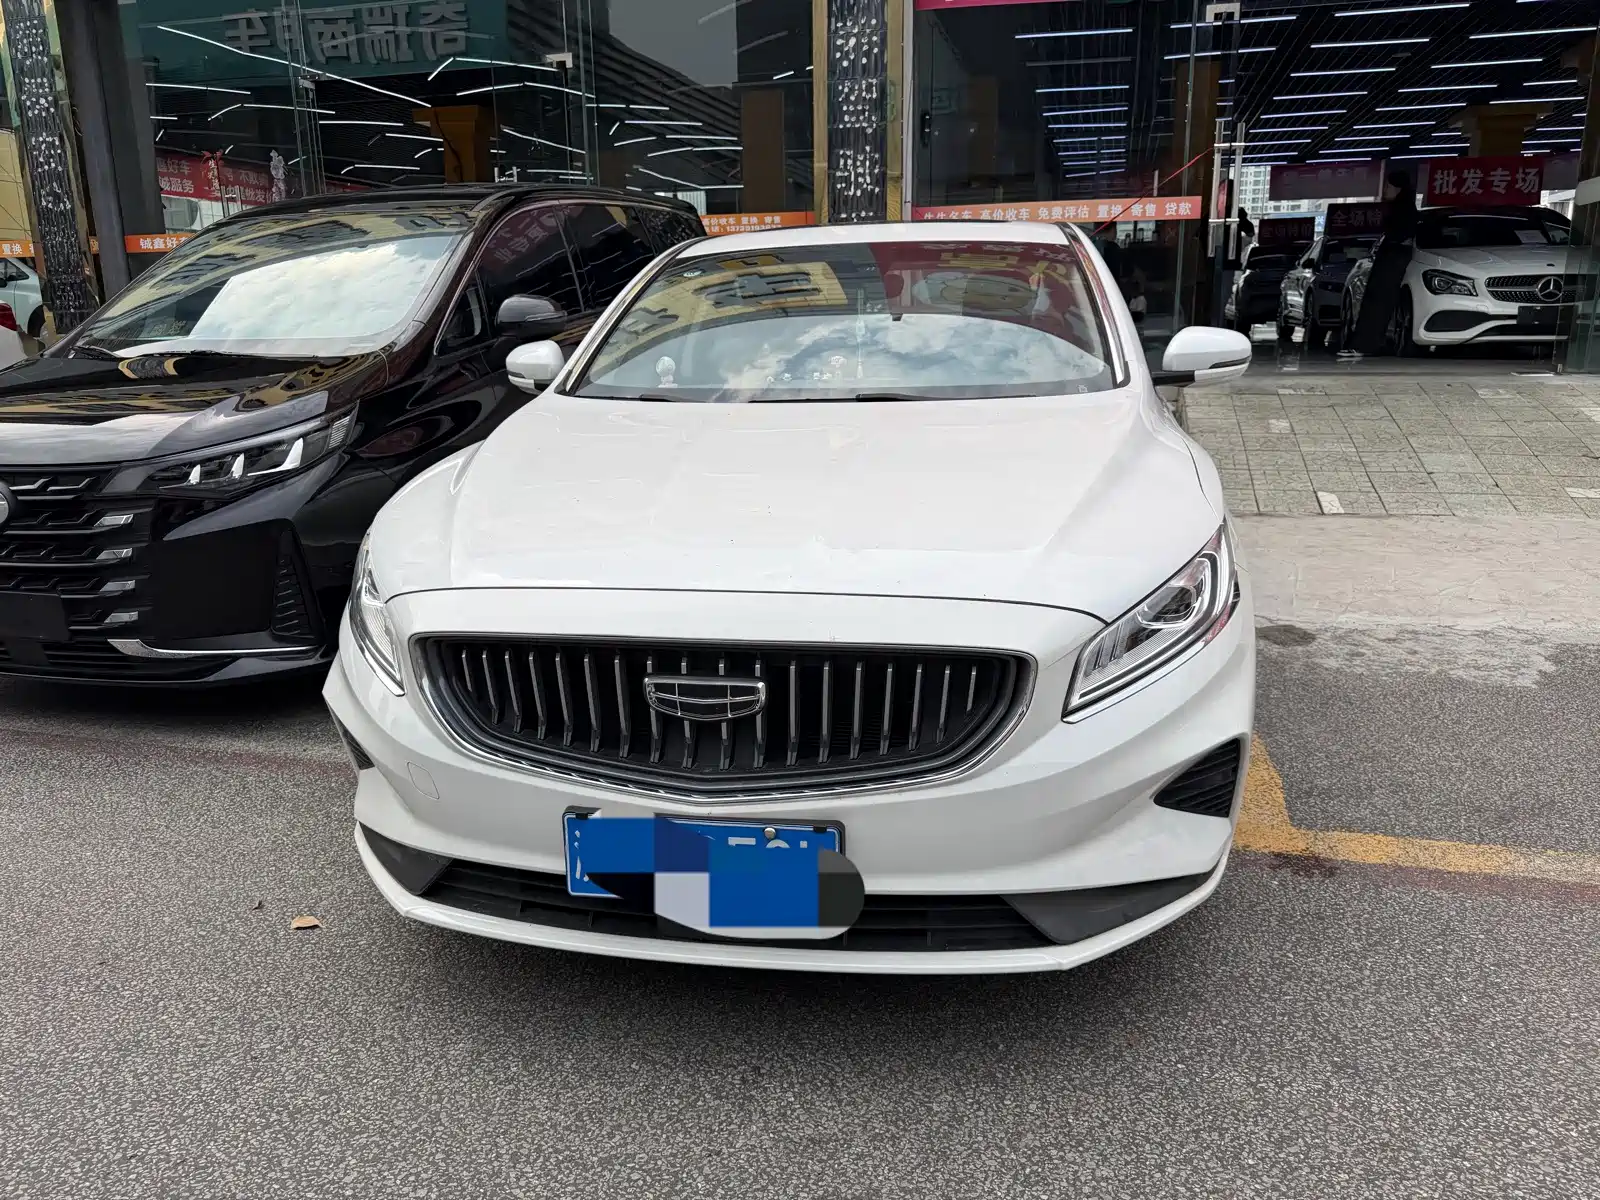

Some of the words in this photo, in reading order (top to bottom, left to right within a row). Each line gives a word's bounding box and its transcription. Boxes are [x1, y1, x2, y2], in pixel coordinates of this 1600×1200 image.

[1433, 165, 1540, 195] 批发专场
[980, 207, 1030, 220] 高价收车
[1037, 204, 1089, 220] 免费评估
[1097, 204, 1123, 218] 置换
[1131, 202, 1156, 217] 寄售
[1165, 202, 1192, 215] 贷款
[2, 243, 22, 255] 置换
